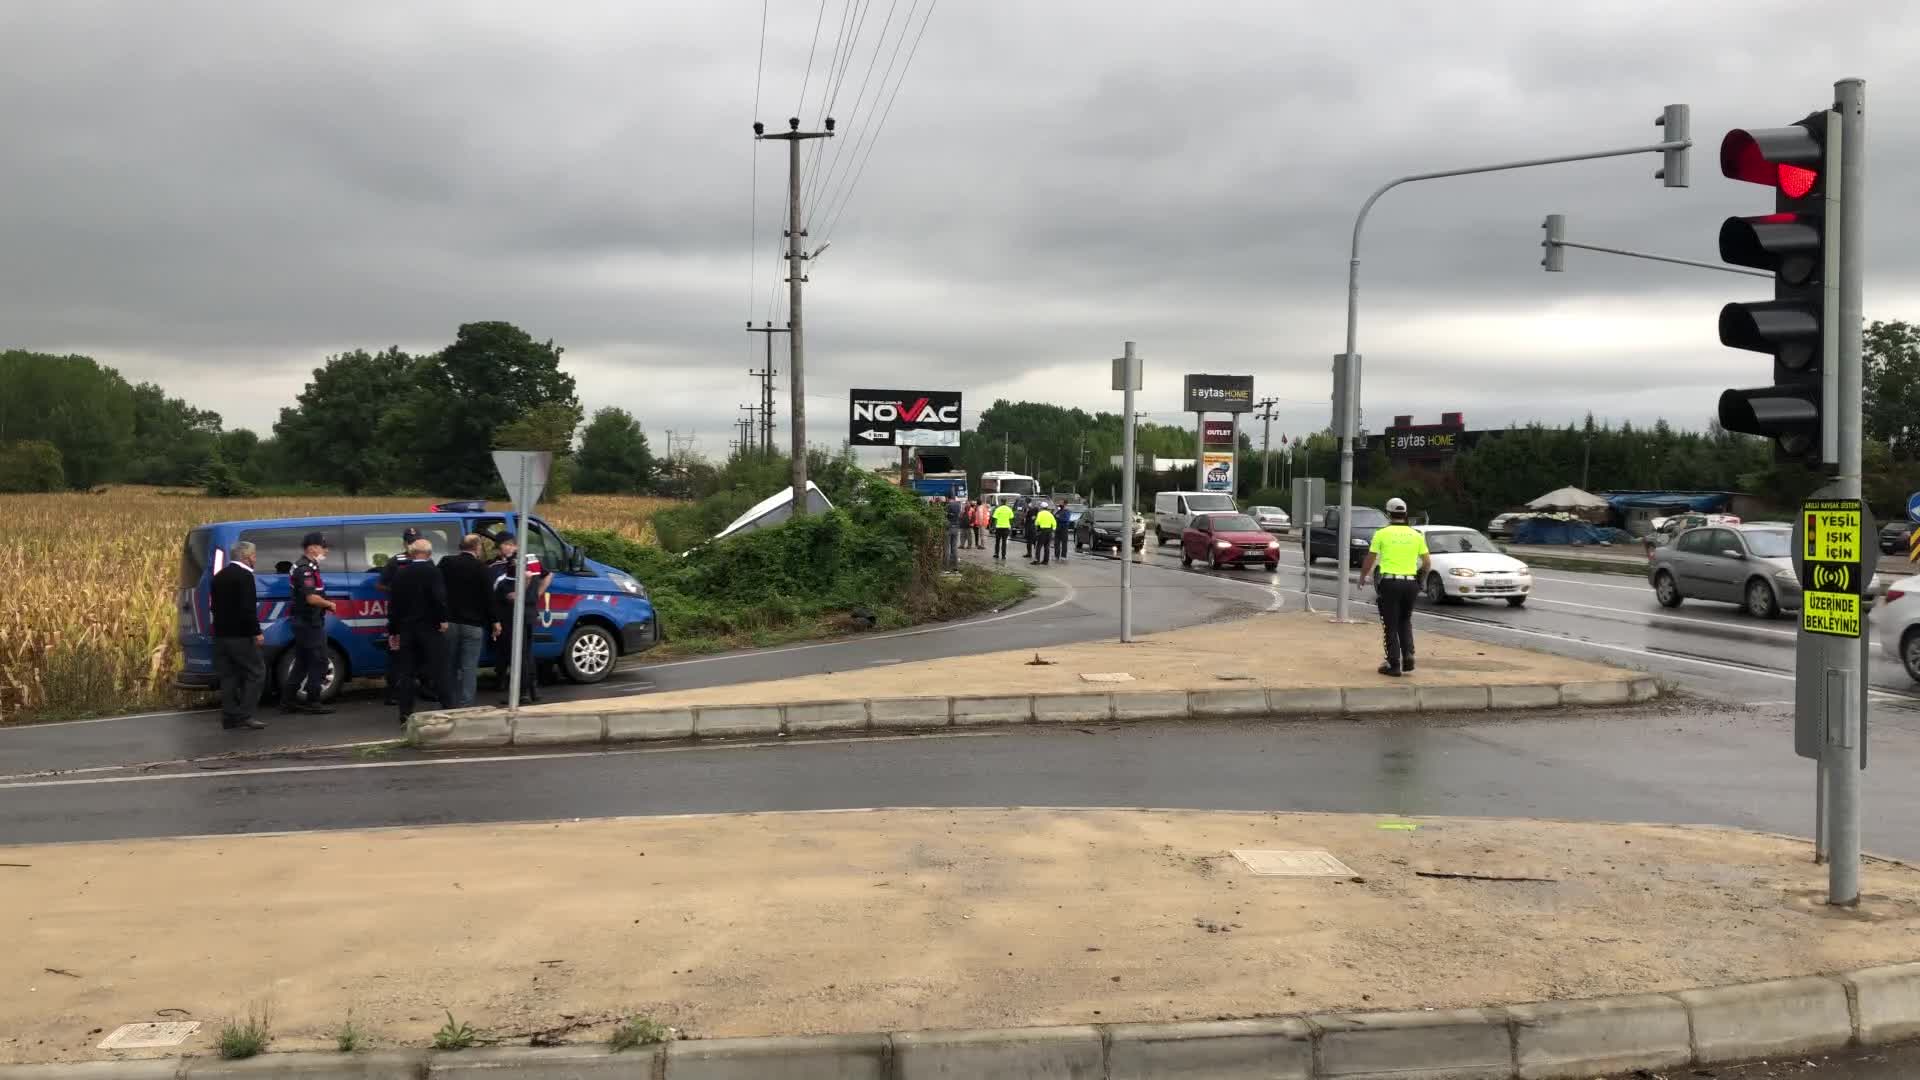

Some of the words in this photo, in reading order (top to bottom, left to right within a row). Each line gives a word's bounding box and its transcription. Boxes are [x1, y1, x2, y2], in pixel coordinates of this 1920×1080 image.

[853, 397, 959, 423] NOVAC
[1428, 434, 1455, 446] HOME
[1821, 513, 1859, 528] YEŞİL
[1826, 532, 1852, 544] IŞIK
[1826, 546, 1852, 559] İÇİN
[1810, 593, 1854, 612] ÜZERİNDE
[1806, 615, 1858, 633] BEKLEYİNİZ
